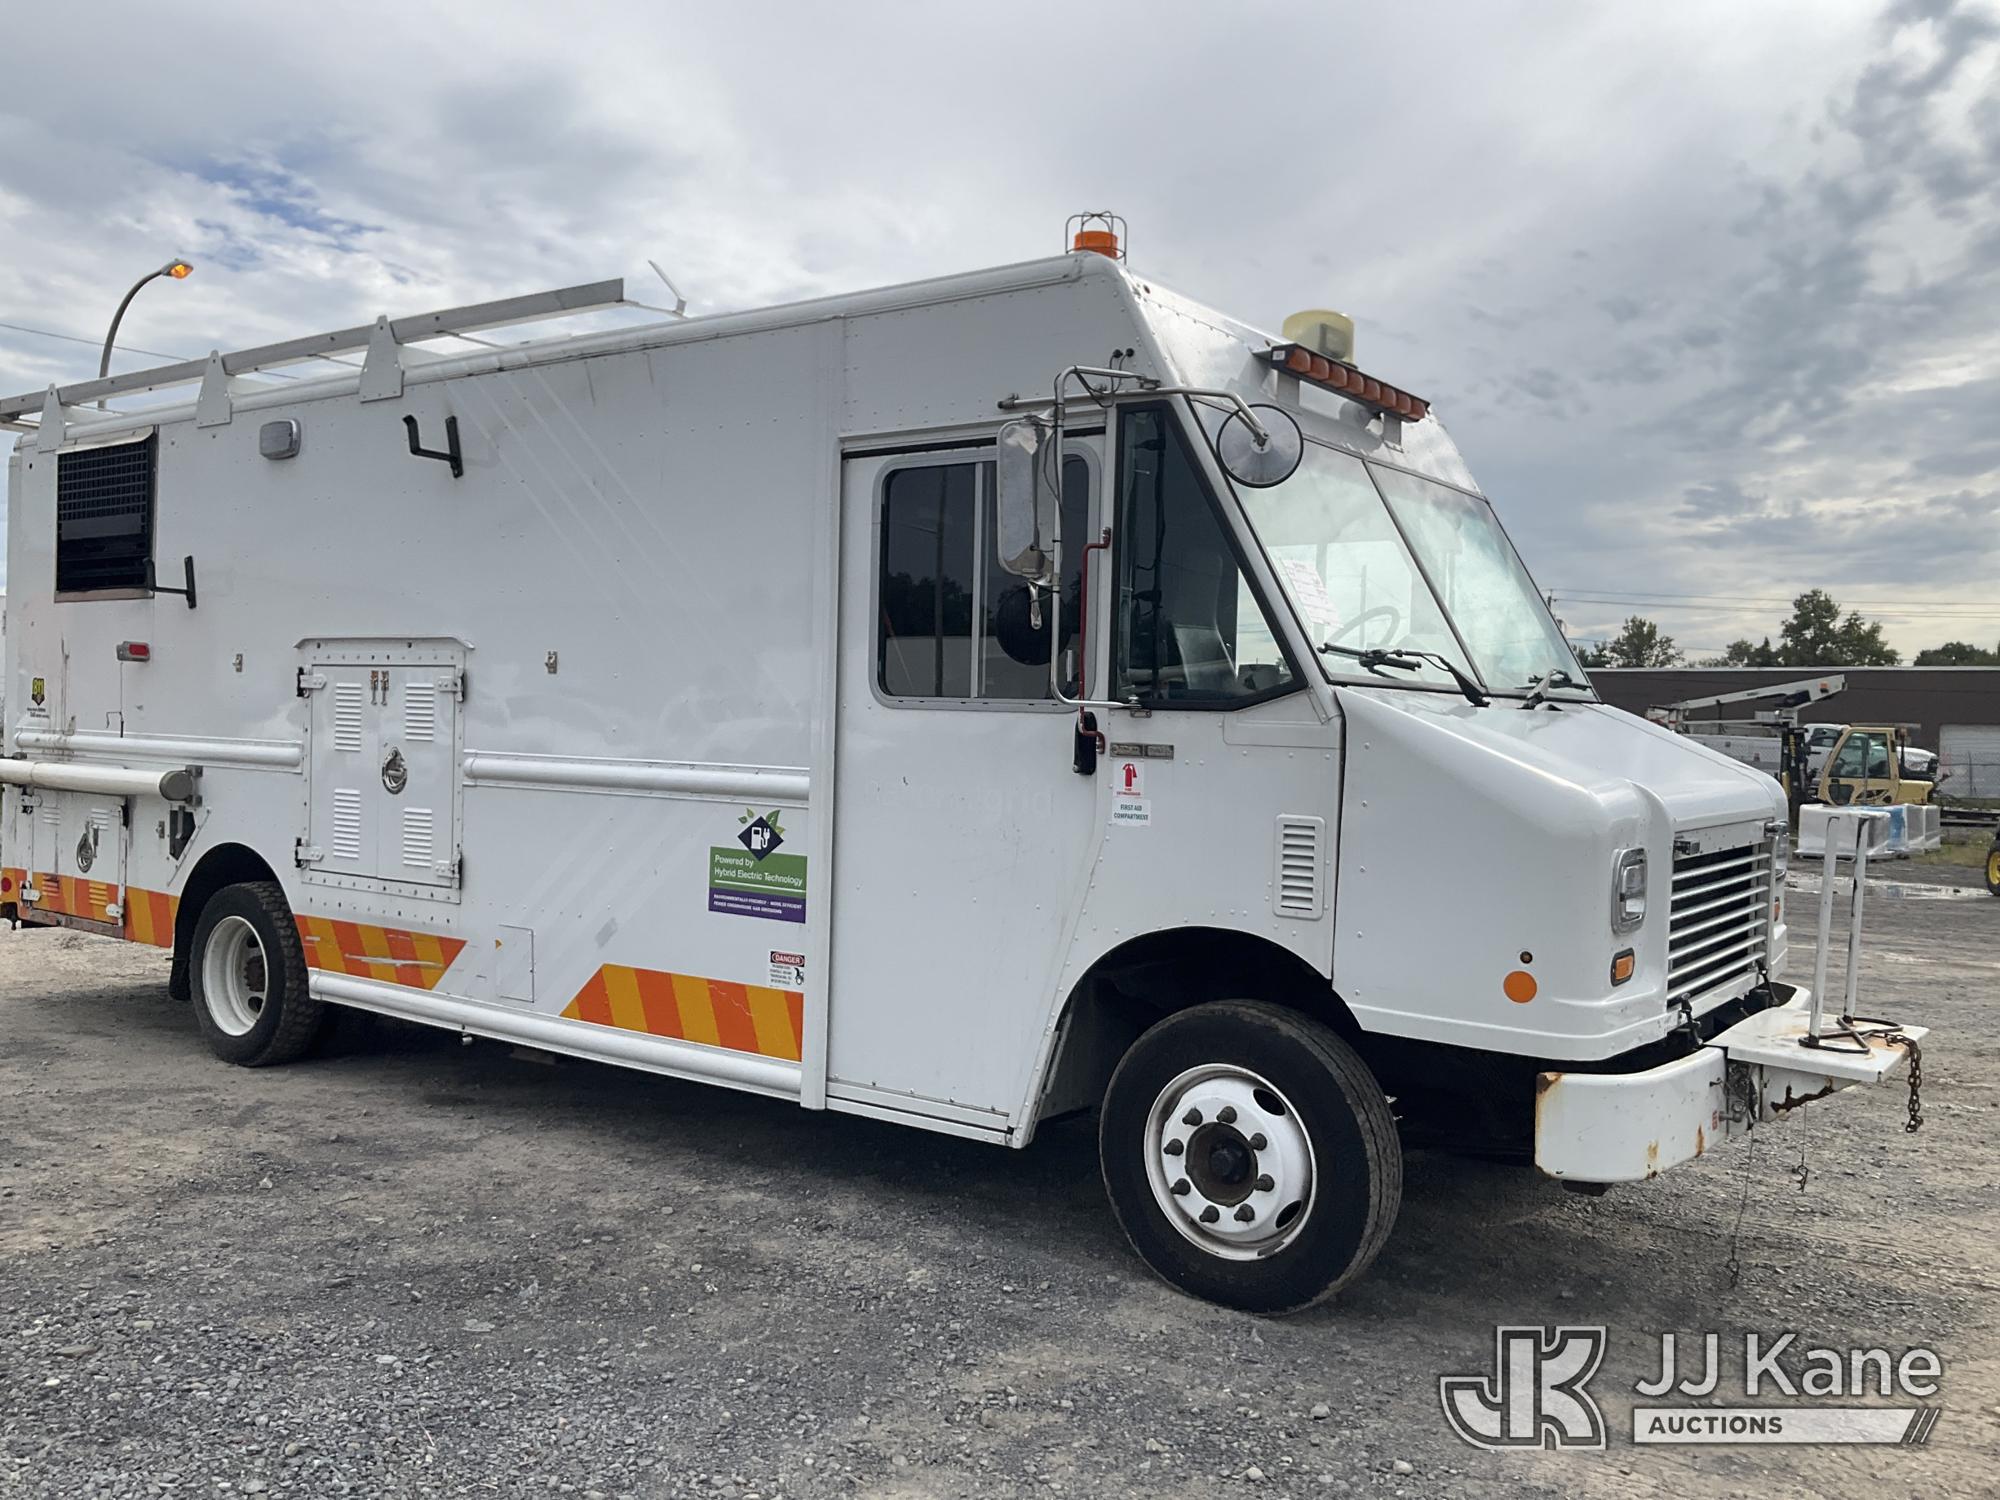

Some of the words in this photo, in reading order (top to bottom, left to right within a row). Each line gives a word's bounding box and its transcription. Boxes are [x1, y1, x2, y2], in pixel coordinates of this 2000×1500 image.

[1114, 812, 1148, 820] COMPARTMENT
[714, 854, 743, 866] Powered
[745, 858, 754, 868] by
[714, 867, 736, 878] Hybrid
[738, 870, 762, 880] Electric
[764, 872, 803, 886] Technology
[776, 954, 800, 964] DANGER
